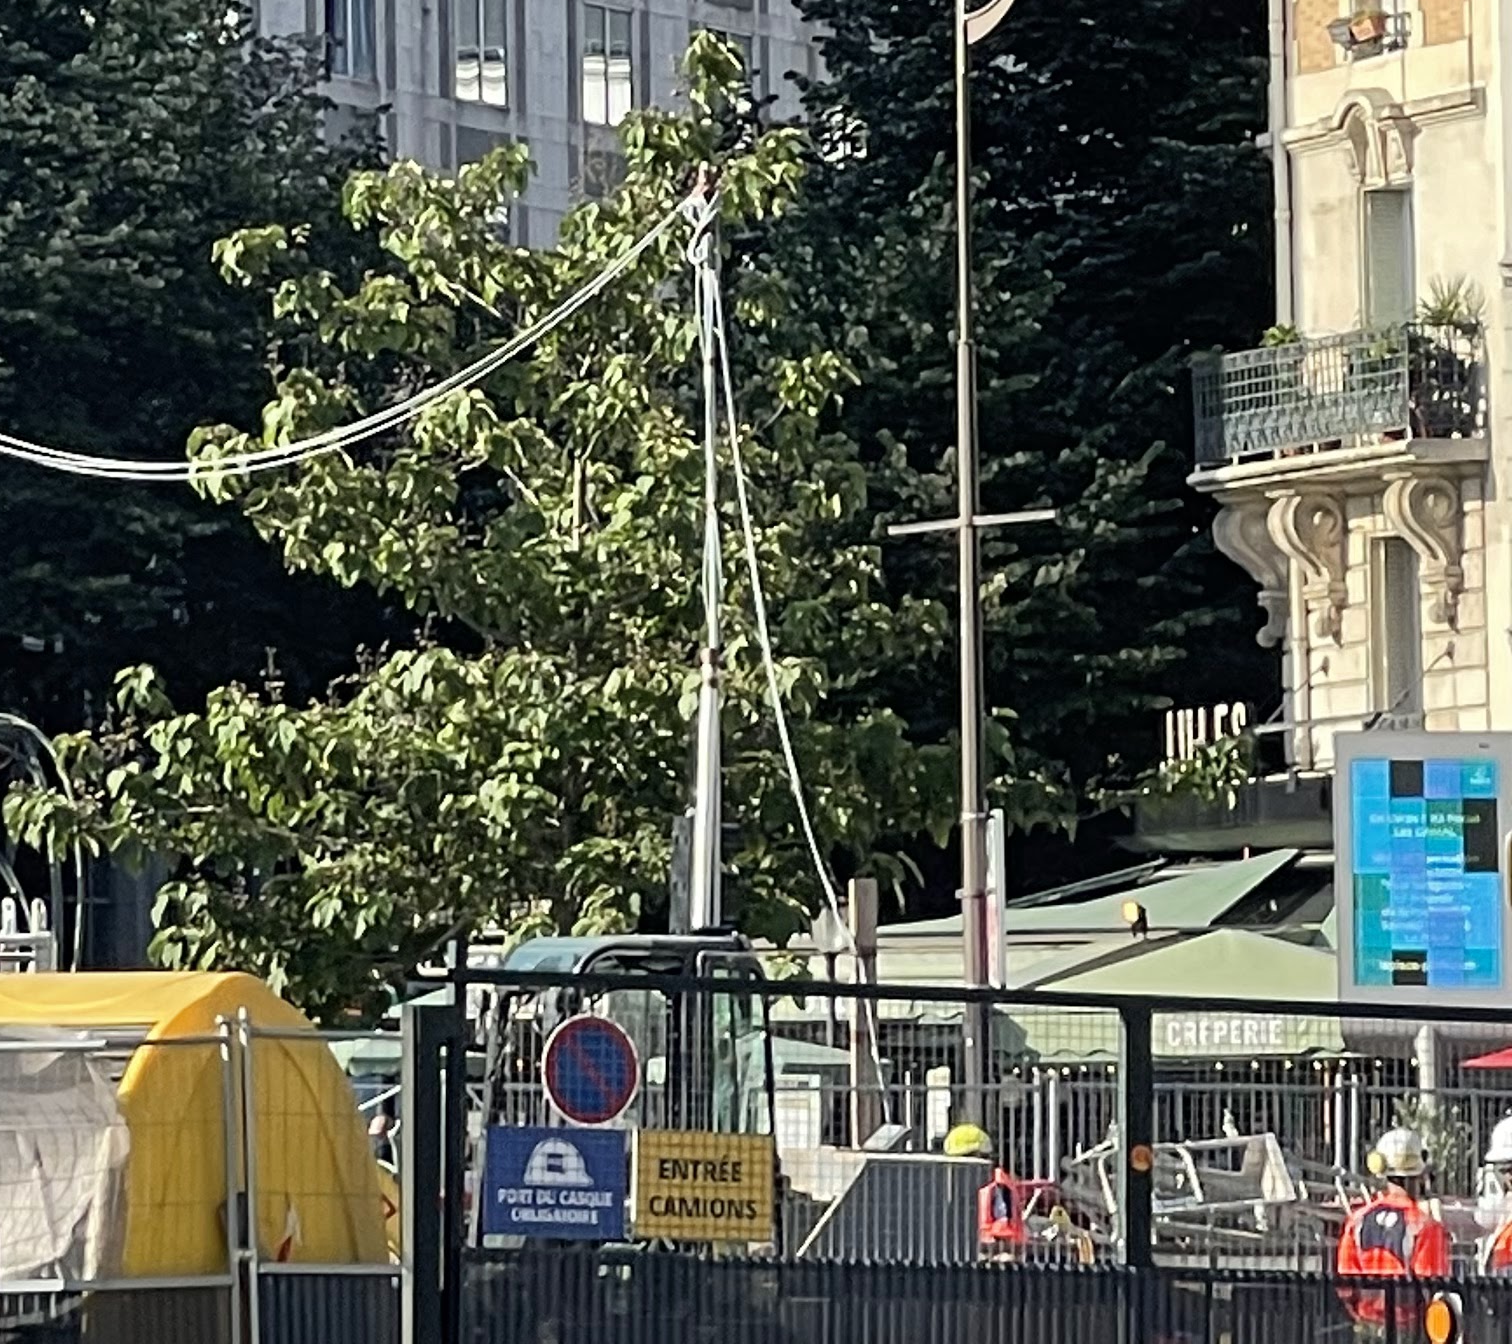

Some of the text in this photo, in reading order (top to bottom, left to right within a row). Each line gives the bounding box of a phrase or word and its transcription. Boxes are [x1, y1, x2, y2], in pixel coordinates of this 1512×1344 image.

[658, 1154, 743, 1183] ENTRÉE
[497, 1188, 613, 1207] PORT DU CASQUE
[649, 1195, 758, 1220] CAMIONS
